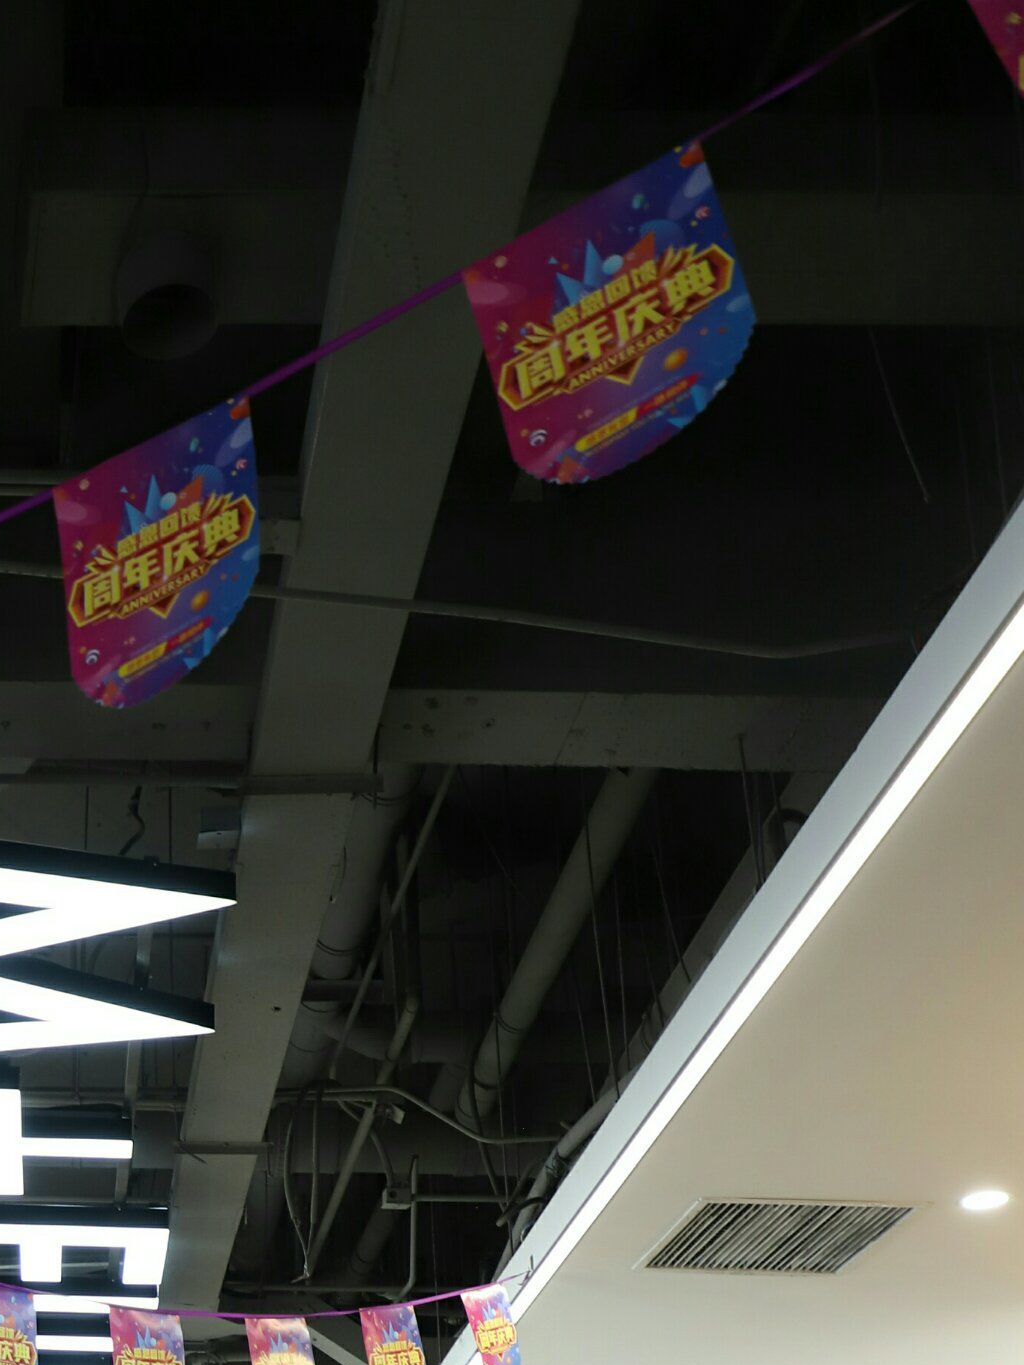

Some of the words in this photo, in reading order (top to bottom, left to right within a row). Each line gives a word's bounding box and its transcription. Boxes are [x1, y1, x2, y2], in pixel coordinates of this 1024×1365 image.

[516, 260, 717, 399] 周年庆典
[567, 322, 676, 391] ANNIVERSARY
[84, 508, 241, 617] 周年庆典
[121, 564, 206, 615] ANNIVERSARY
